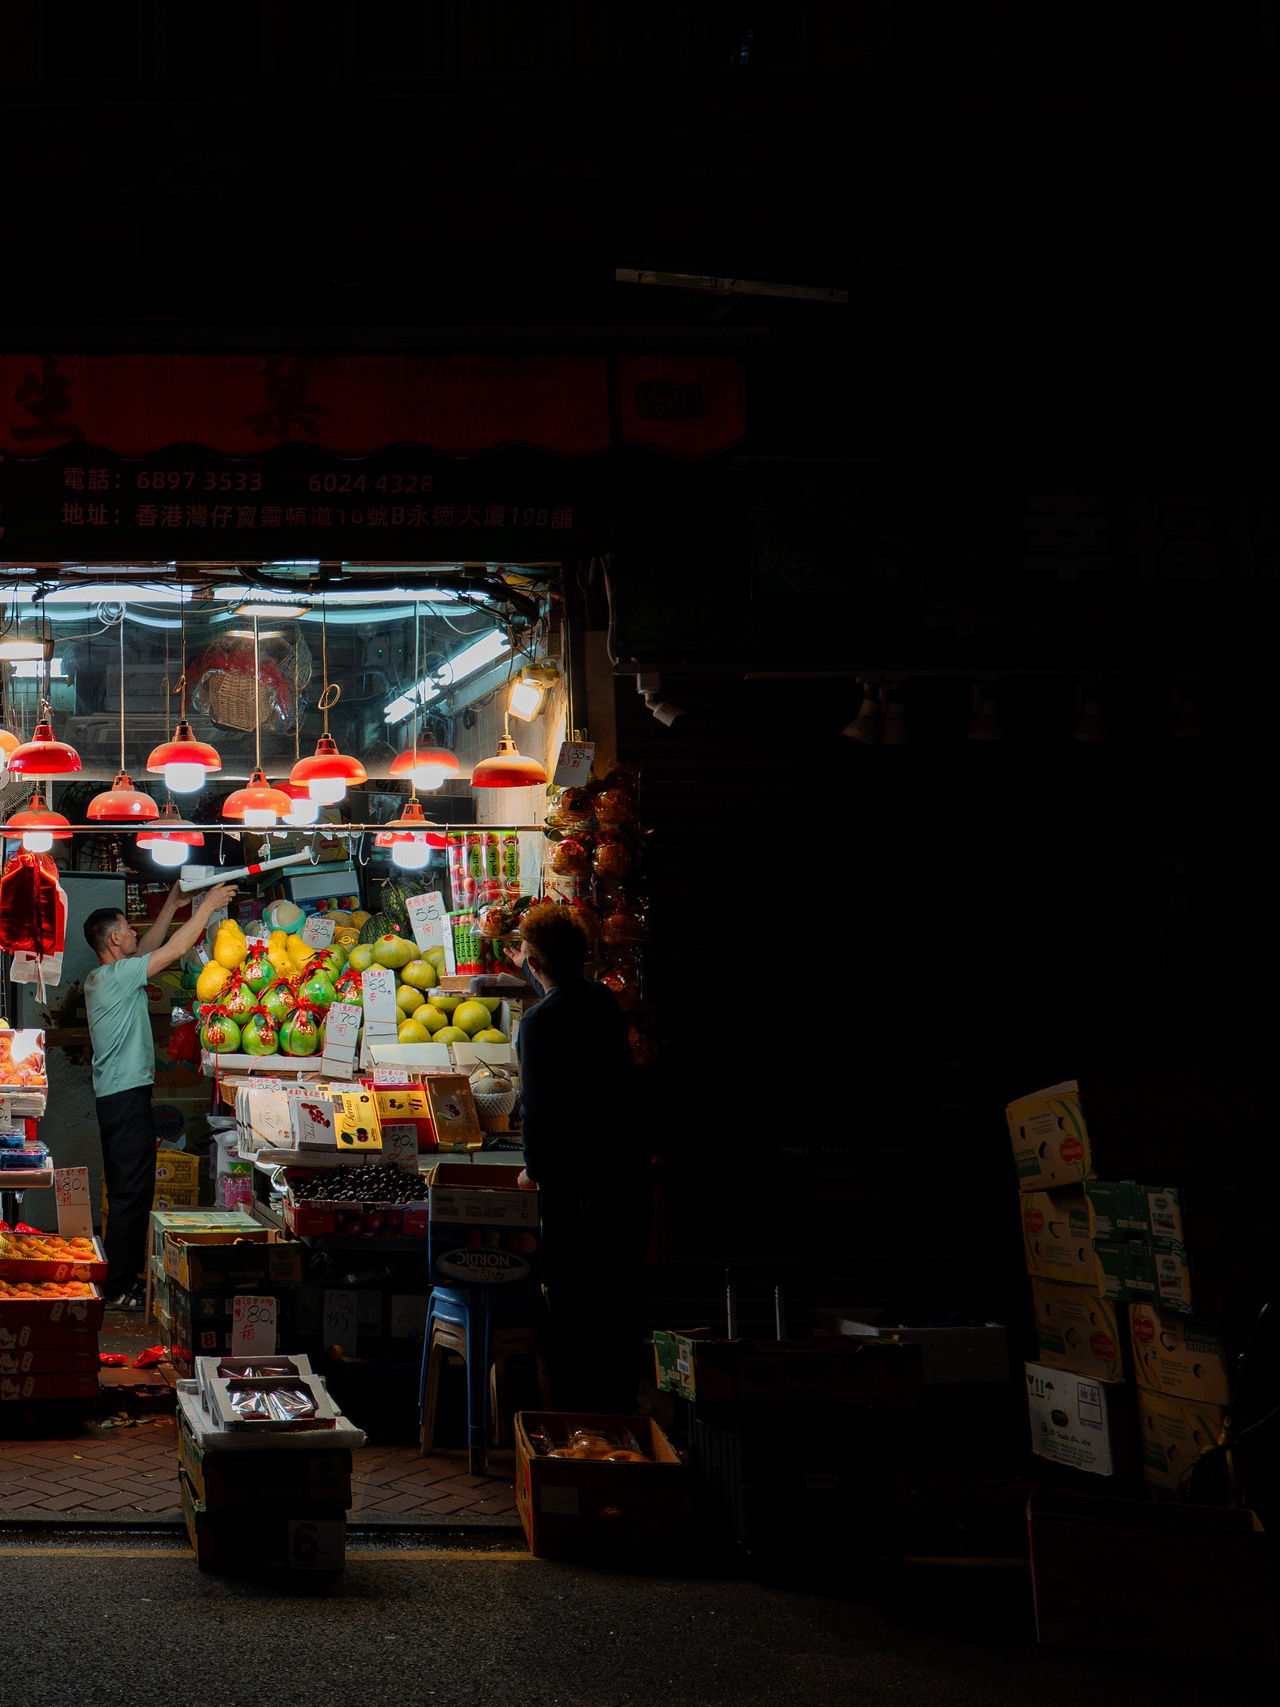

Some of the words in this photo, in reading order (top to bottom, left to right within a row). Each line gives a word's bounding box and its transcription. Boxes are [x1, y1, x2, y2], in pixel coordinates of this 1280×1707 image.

[136, 471, 194, 490] 6897
[204, 473, 262, 491] 3533
[308, 474, 366, 492] 6024
[375, 475, 434, 493] 4328
[456, 1252, 510, 1267] NORDIC
